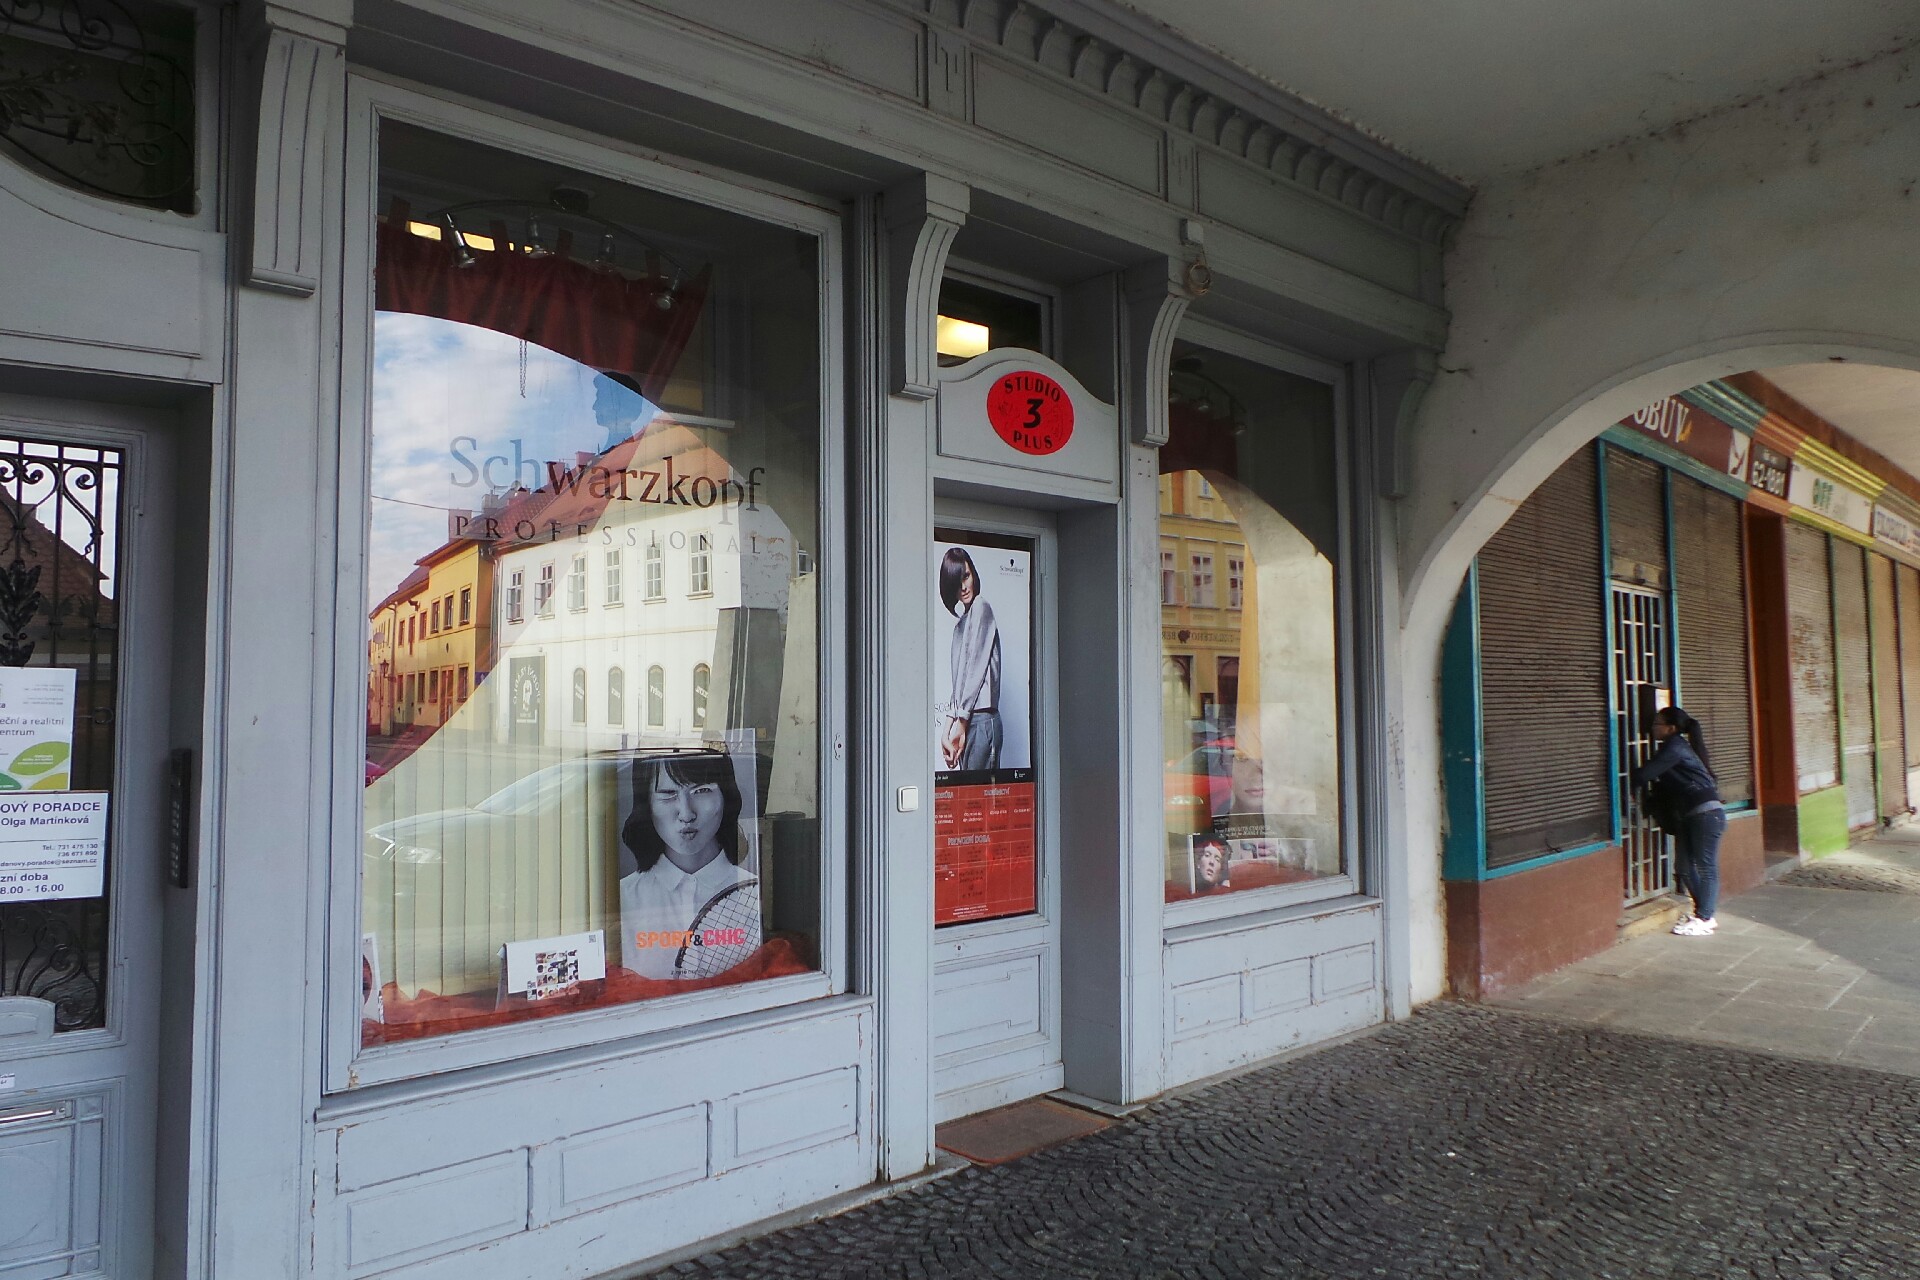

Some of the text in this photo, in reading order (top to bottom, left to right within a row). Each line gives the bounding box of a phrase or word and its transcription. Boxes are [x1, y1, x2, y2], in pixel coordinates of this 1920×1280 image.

[1004, 376, 1060, 402] STUDIO
[1023, 398, 1044, 429] 3
[1013, 430, 1053, 450] PLUS
[450, 435, 765, 525] Schwarzkopf
[455, 515, 761, 554] PROFESSIONAL
[0, 801, 101, 813] OVÝ PORADCE
[1, 815, 89, 828] Olga Martínková
[20, 873, 48, 882] doba
[35, 883, 64, 893] 16.00
